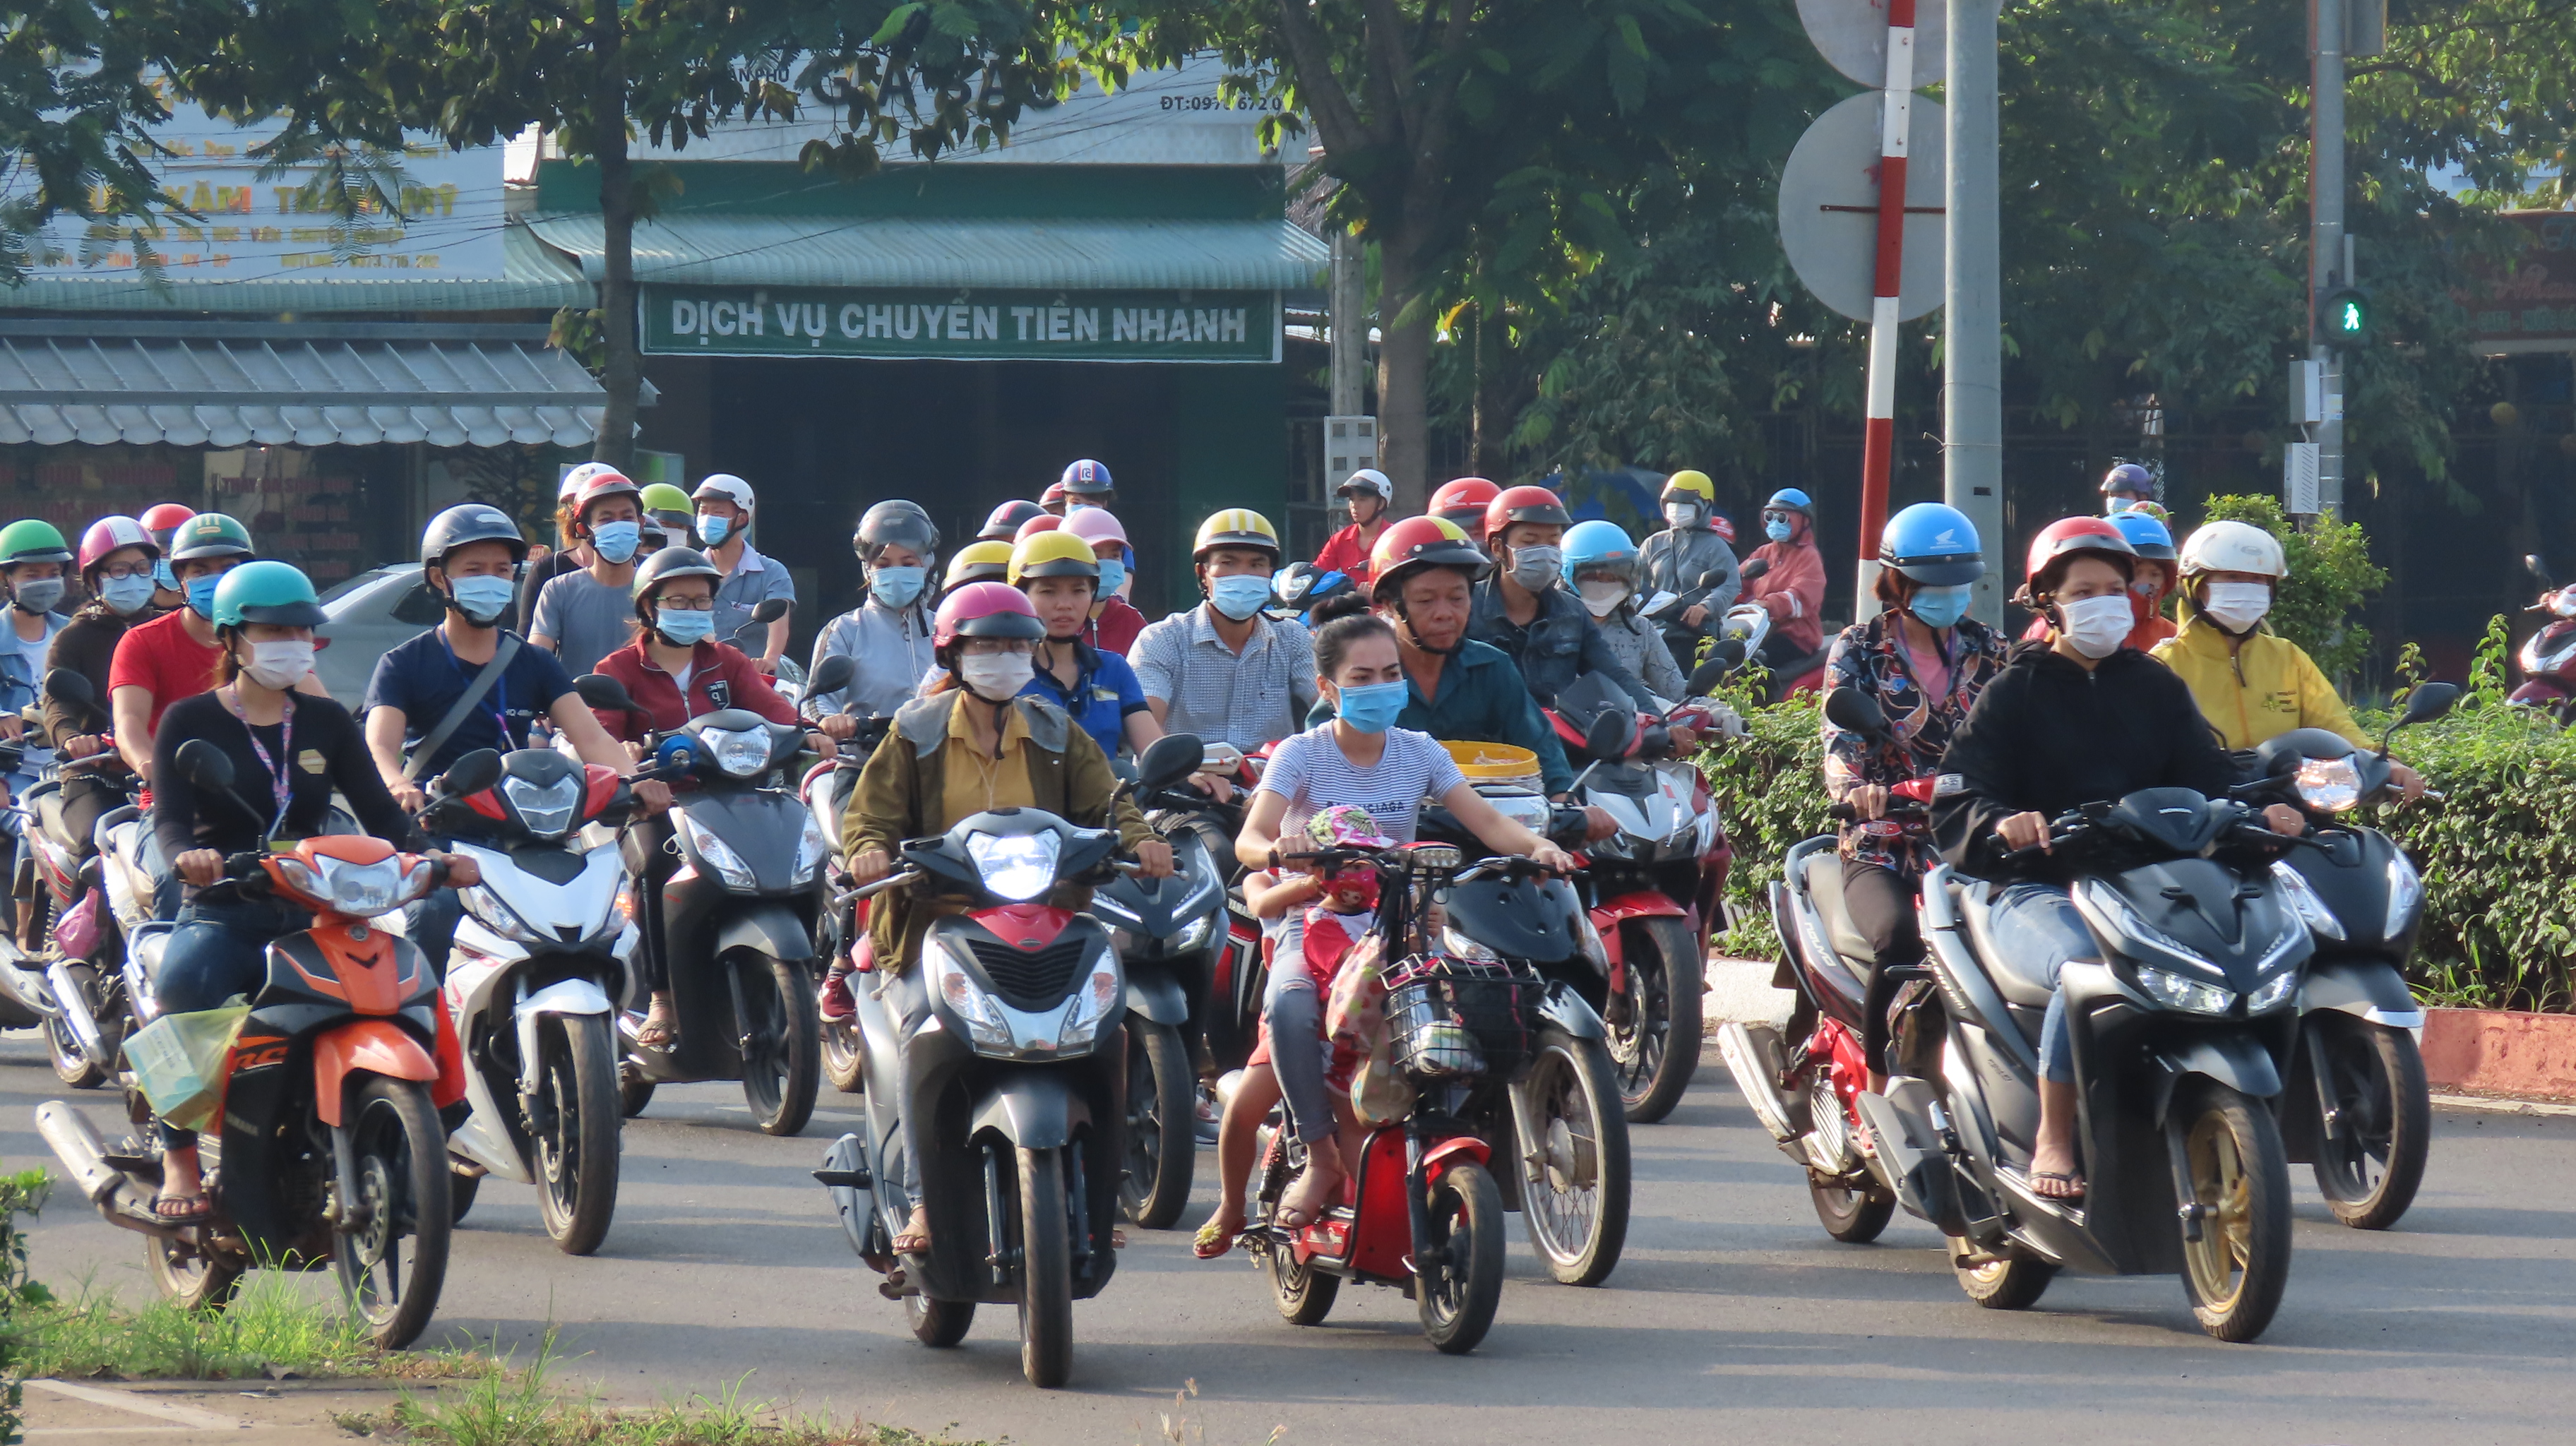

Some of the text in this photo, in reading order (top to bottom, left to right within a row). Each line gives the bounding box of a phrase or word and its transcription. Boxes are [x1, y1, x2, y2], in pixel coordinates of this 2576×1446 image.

[672, 289, 1246, 348] DỊCH VỤ CHUYỂN TIỀN NHANH
